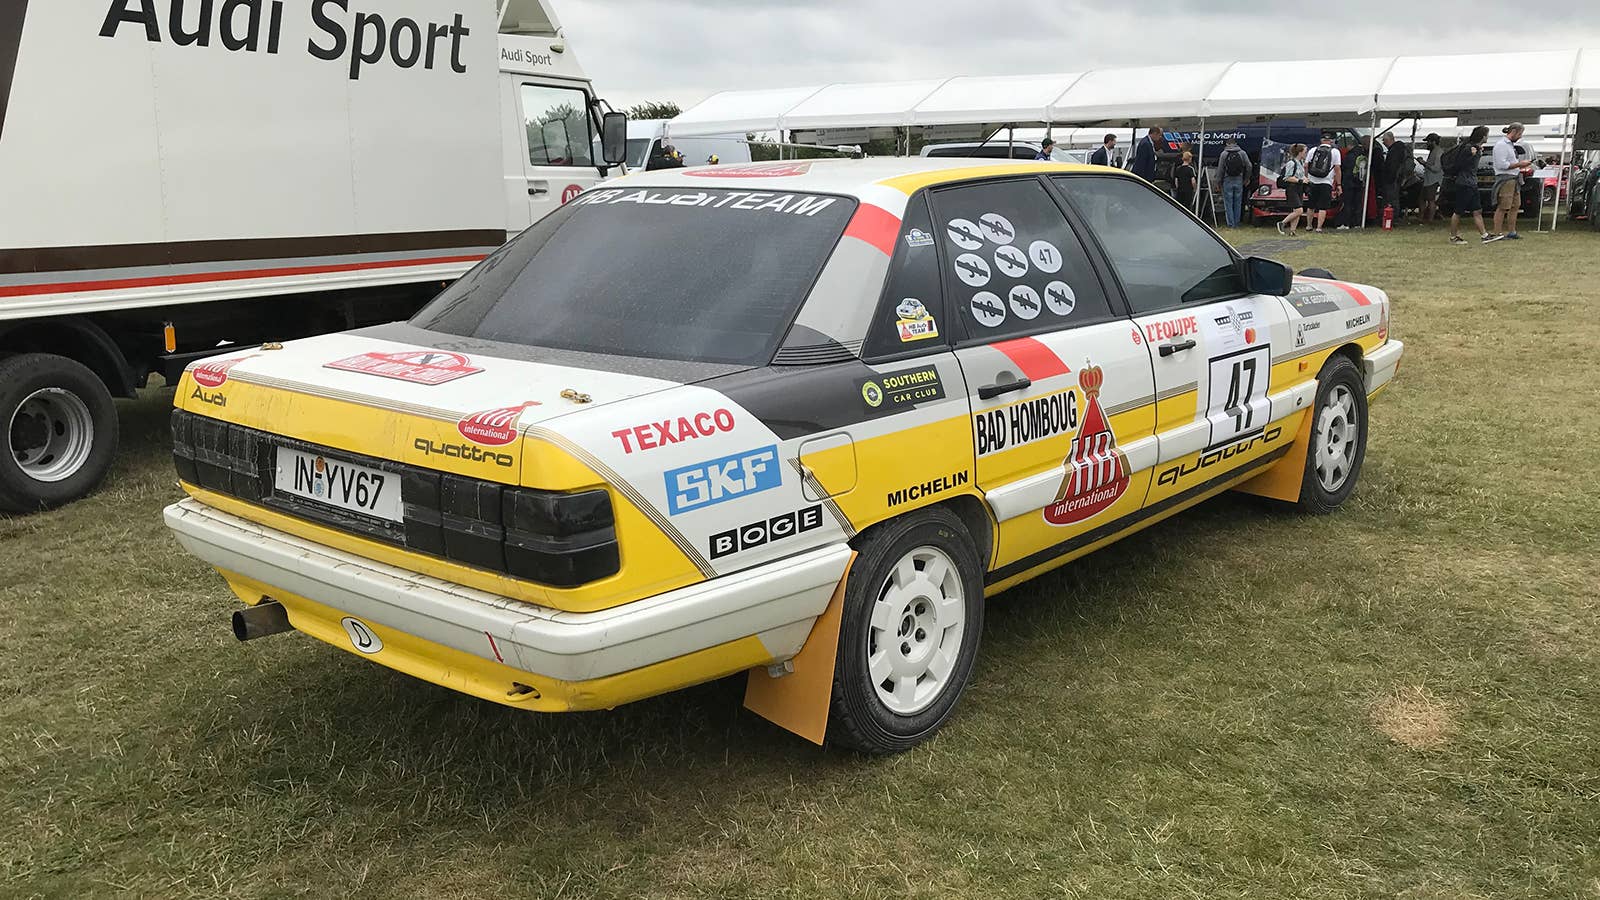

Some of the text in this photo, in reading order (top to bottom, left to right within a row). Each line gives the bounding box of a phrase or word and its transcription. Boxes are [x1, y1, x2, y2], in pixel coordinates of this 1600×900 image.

[98, 0, 470, 80] Audi Sport
[501, 48, 552, 66] Audi Sport
[713, 192, 837, 217] TEAM
[1040, 249, 1052, 264] 47
[1346, 313, 1371, 329] MICHELIN
[883, 369, 937, 389] SOUTHERN
[191, 385, 227, 407] Audi
[893, 393, 912, 403] CAR
[915, 388, 937, 399] CLUB
[1223, 357, 1257, 433] 47
[463, 423, 511, 440] international
[611, 408, 735, 454] TEXACO
[976, 390, 1077, 455] BAD HOMBOUG
[414, 437, 514, 467] quattro
[676, 450, 777, 512] SKF
[887, 470, 969, 507] MICHELIN
[1054, 482, 1119, 517] international
[715, 511, 819, 554] BOGE
[350, 620, 372, 648] D
